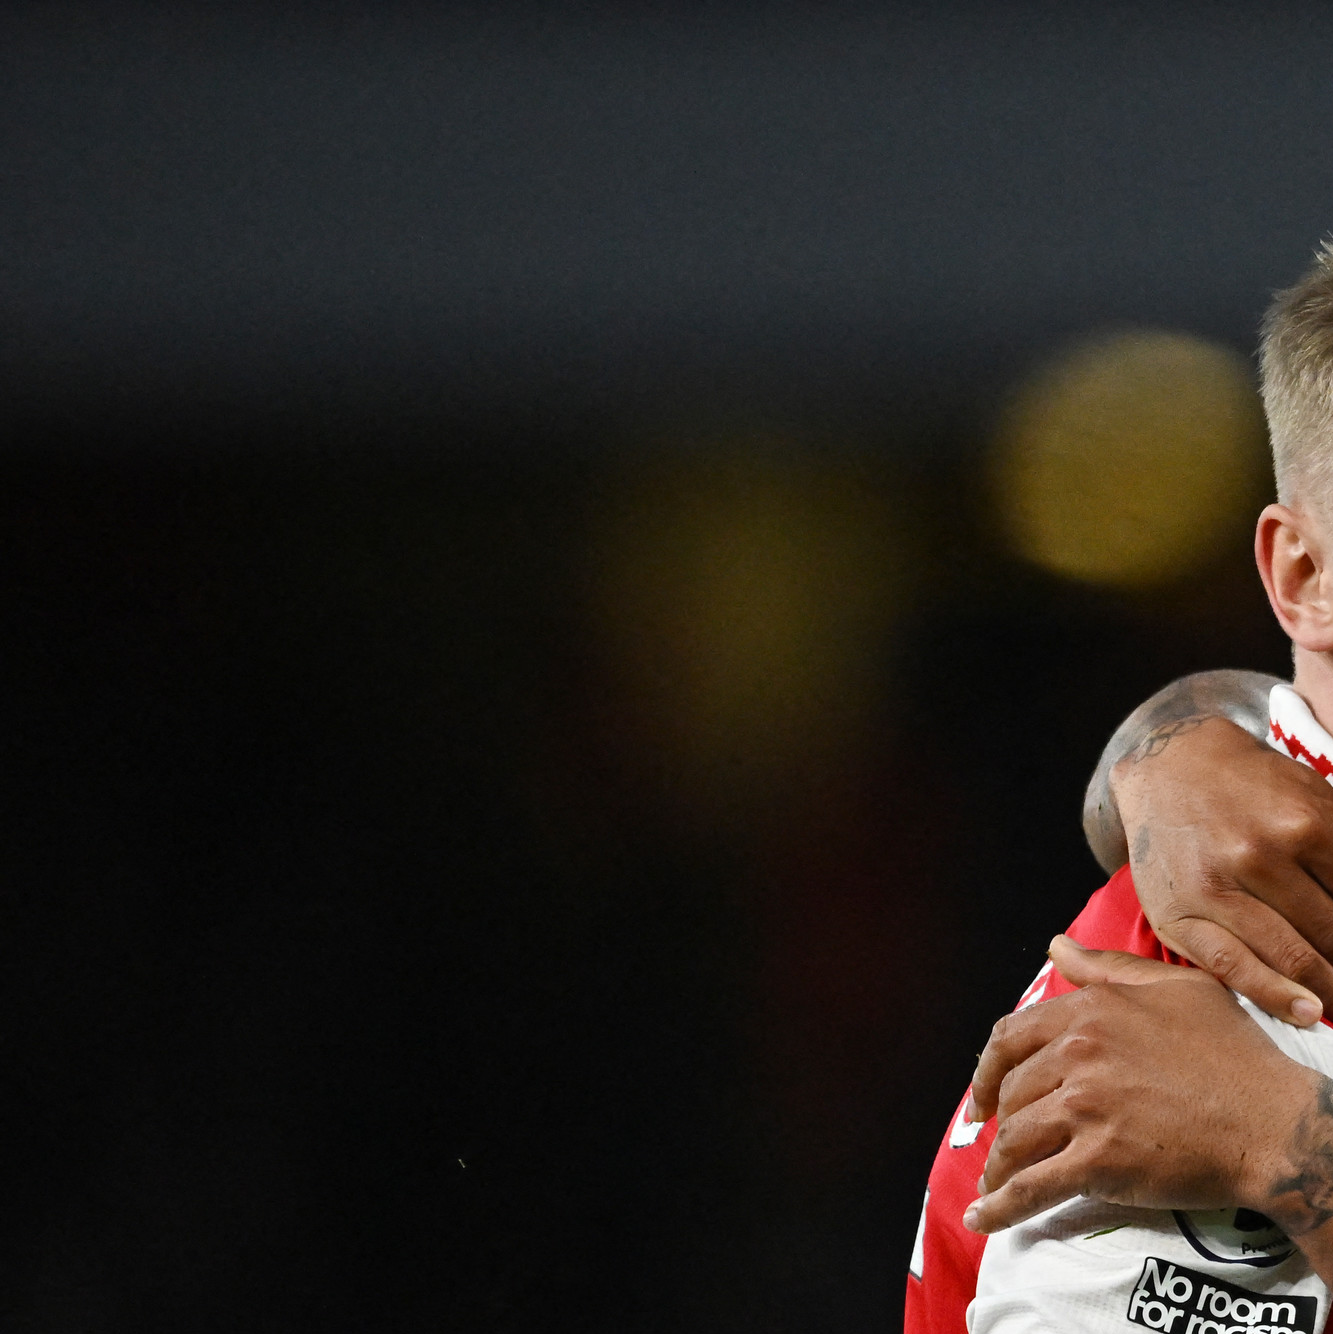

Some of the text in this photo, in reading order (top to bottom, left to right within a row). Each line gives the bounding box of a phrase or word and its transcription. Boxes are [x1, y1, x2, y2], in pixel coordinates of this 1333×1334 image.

[1129, 1288, 1185, 1333] for
[1137, 1258, 1297, 1325] No room
